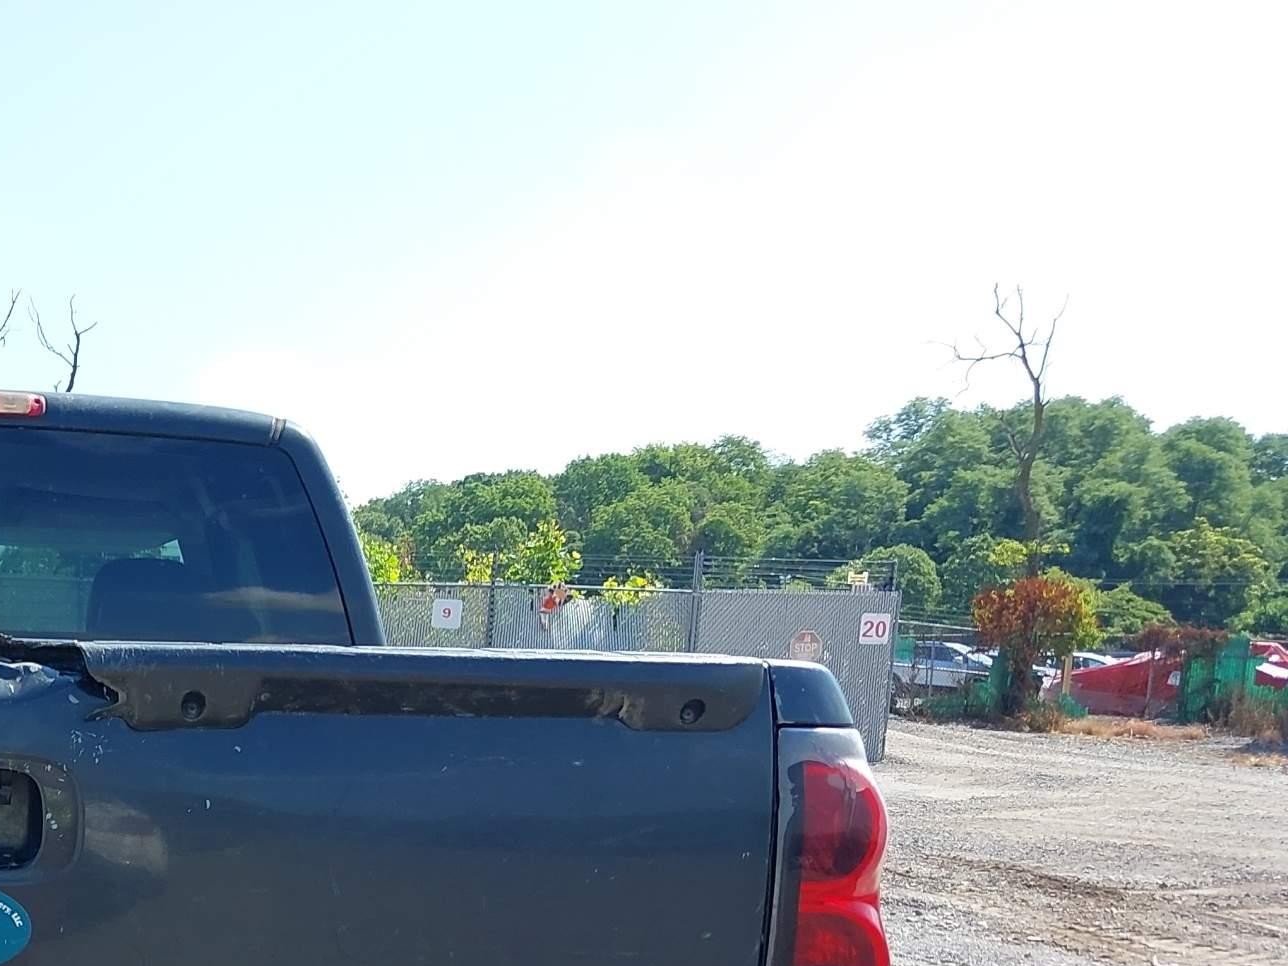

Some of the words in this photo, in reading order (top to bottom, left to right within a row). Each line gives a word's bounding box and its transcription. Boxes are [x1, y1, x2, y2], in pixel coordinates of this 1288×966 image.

[442, 607, 452, 619] 9
[861, 620, 887, 638] 20
[794, 643, 818, 653] STOP
